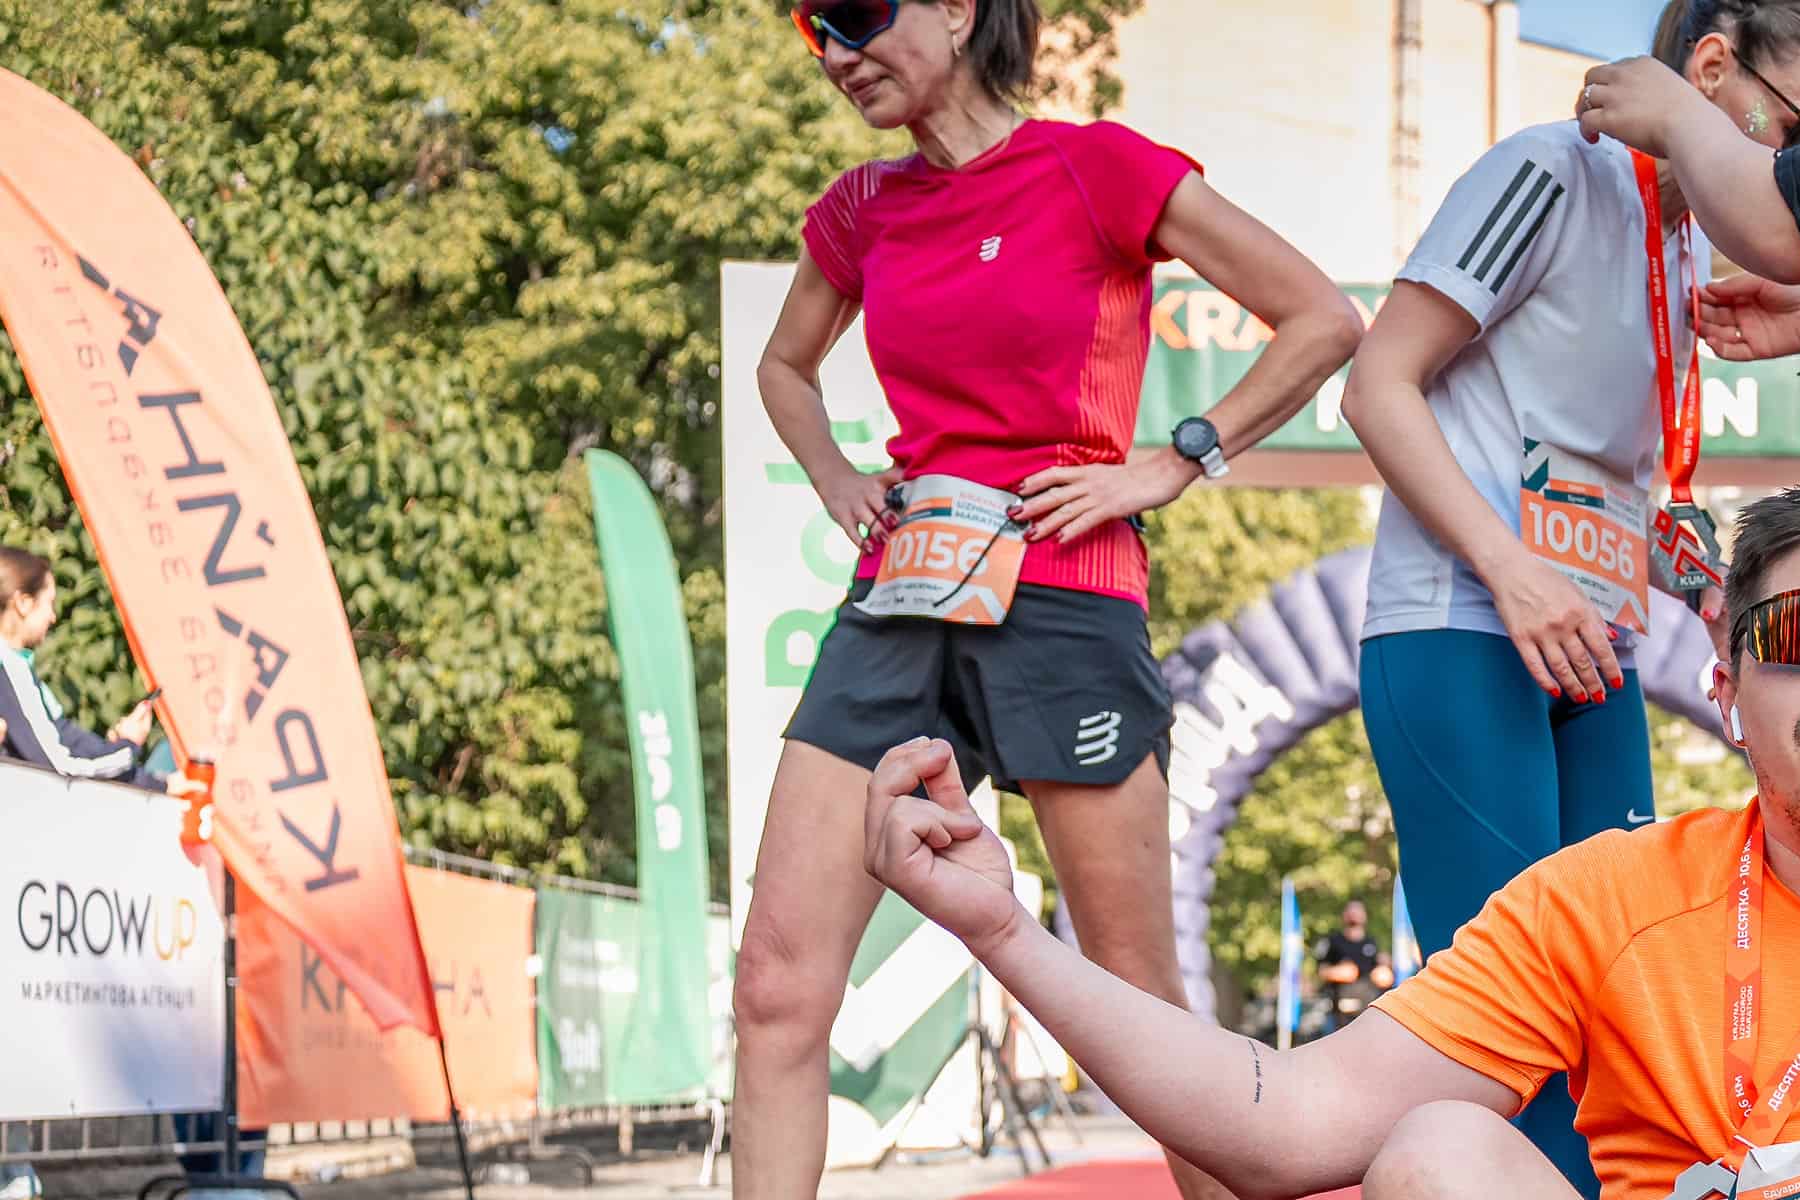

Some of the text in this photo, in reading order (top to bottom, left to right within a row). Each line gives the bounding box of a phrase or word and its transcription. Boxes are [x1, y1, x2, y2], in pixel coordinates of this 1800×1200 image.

[887, 530, 990, 577] 10156
[1528, 502, 1635, 580] 10056
[1679, 574, 1707, 586] KUM
[1740, 854, 1751, 878] 10,6
[1737, 887, 1750, 950] ДЕСЯТКА
[1734, 1074, 1745, 1098] КМ
